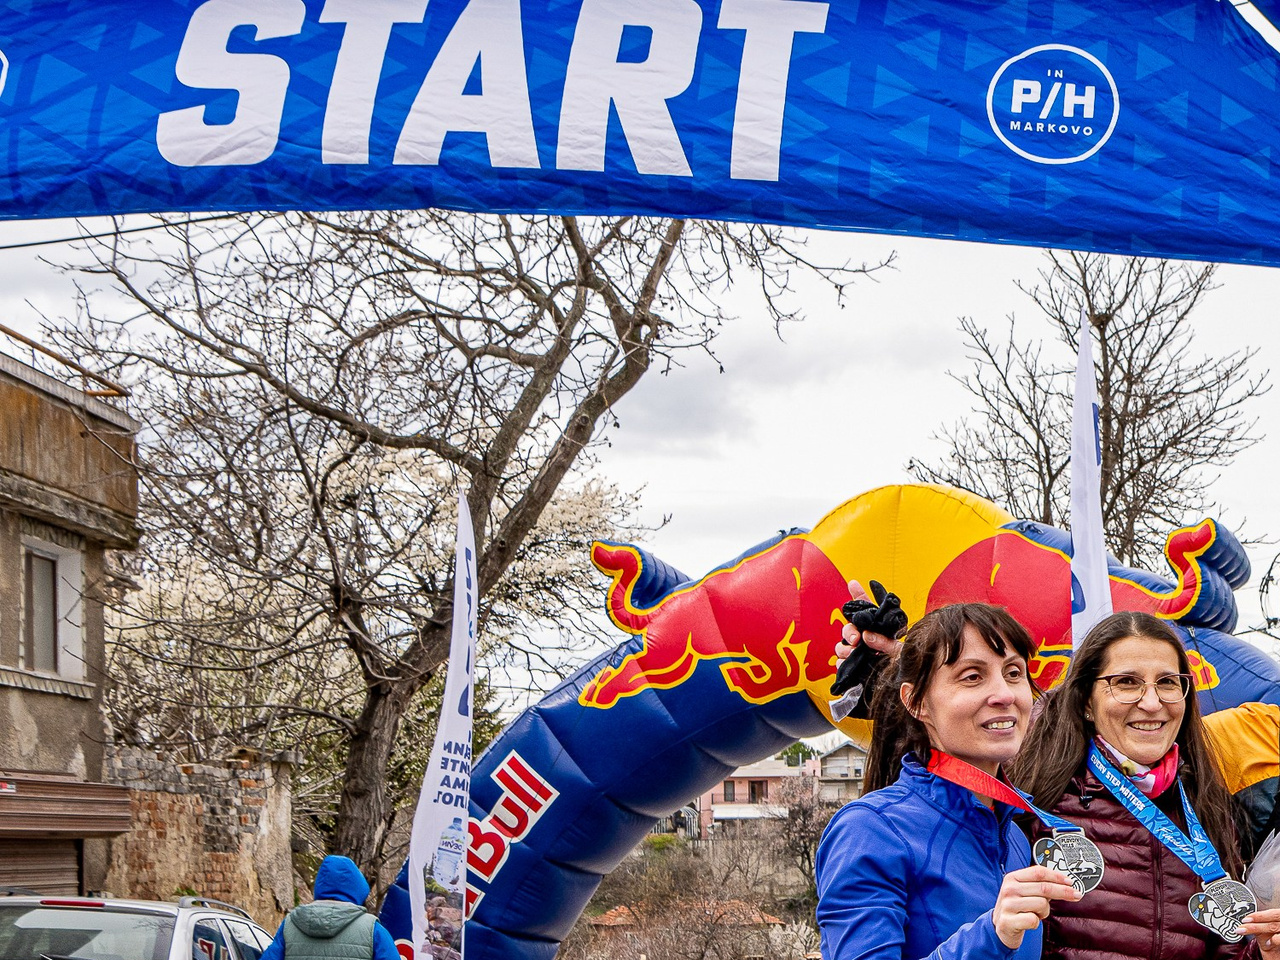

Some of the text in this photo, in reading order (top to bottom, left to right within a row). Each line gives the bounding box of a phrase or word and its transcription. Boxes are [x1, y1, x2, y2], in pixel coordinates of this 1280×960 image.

[156, 0, 828, 182] START
[1047, 70, 1063, 78] IN
[1010, 79, 1096, 119] P/H
[1010, 121, 1093, 136] MARKOVO
[1090, 754, 1146, 811] EVERY STEP MATTERS
